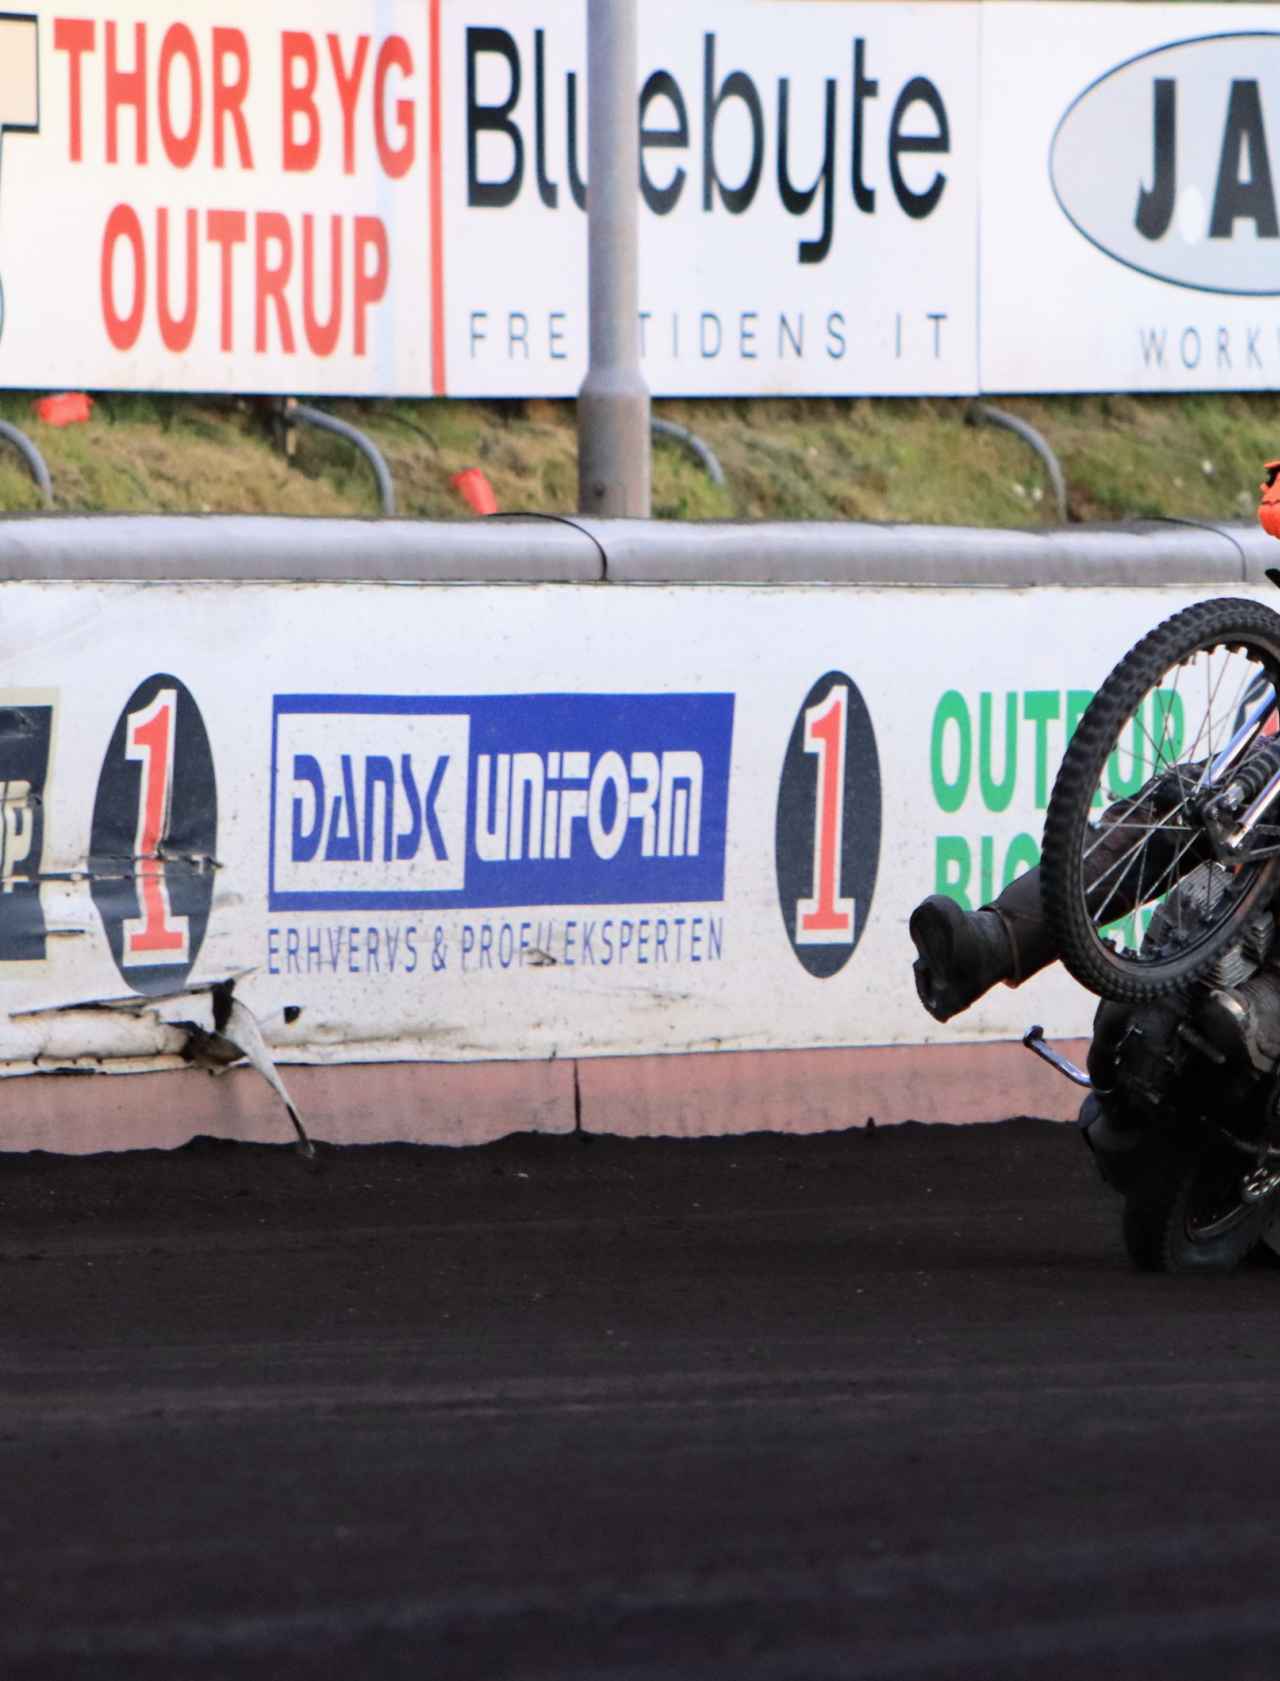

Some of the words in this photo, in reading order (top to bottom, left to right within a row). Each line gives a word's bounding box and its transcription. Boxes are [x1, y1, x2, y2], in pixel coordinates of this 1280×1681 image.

[53, 18, 255, 171] THOR
[281, 30, 416, 180] BYG
[101, 203, 390, 357] OUTRUP
[470, 312, 847, 360] FRETIDENS
[896, 313, 948, 359] IT
[124, 689, 190, 967] 1
[796, 685, 856, 944] 1
[266, 925, 418, 976] ERHVERVS
[431, 925, 448, 973] &
